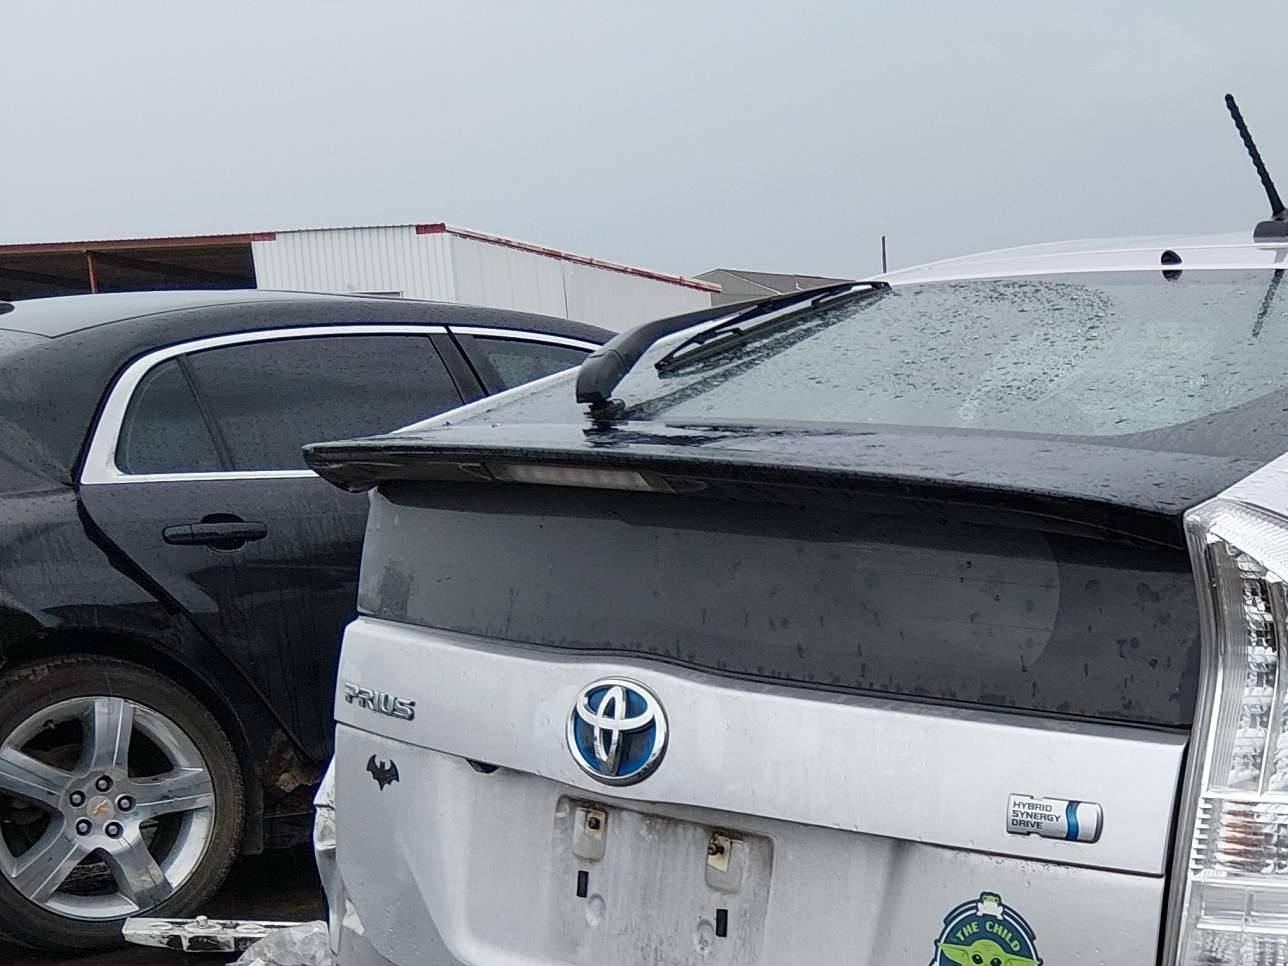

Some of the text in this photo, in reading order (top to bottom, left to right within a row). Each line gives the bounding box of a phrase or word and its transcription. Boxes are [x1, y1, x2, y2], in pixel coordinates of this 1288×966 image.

[344, 682, 416, 721] PRIUS
[1013, 801, 1053, 812] HYBRID
[1012, 810, 1061, 822] SYNERGY
[1011, 818, 1043, 829] DRIVE
[956, 921, 1021, 952] THE CHILD
